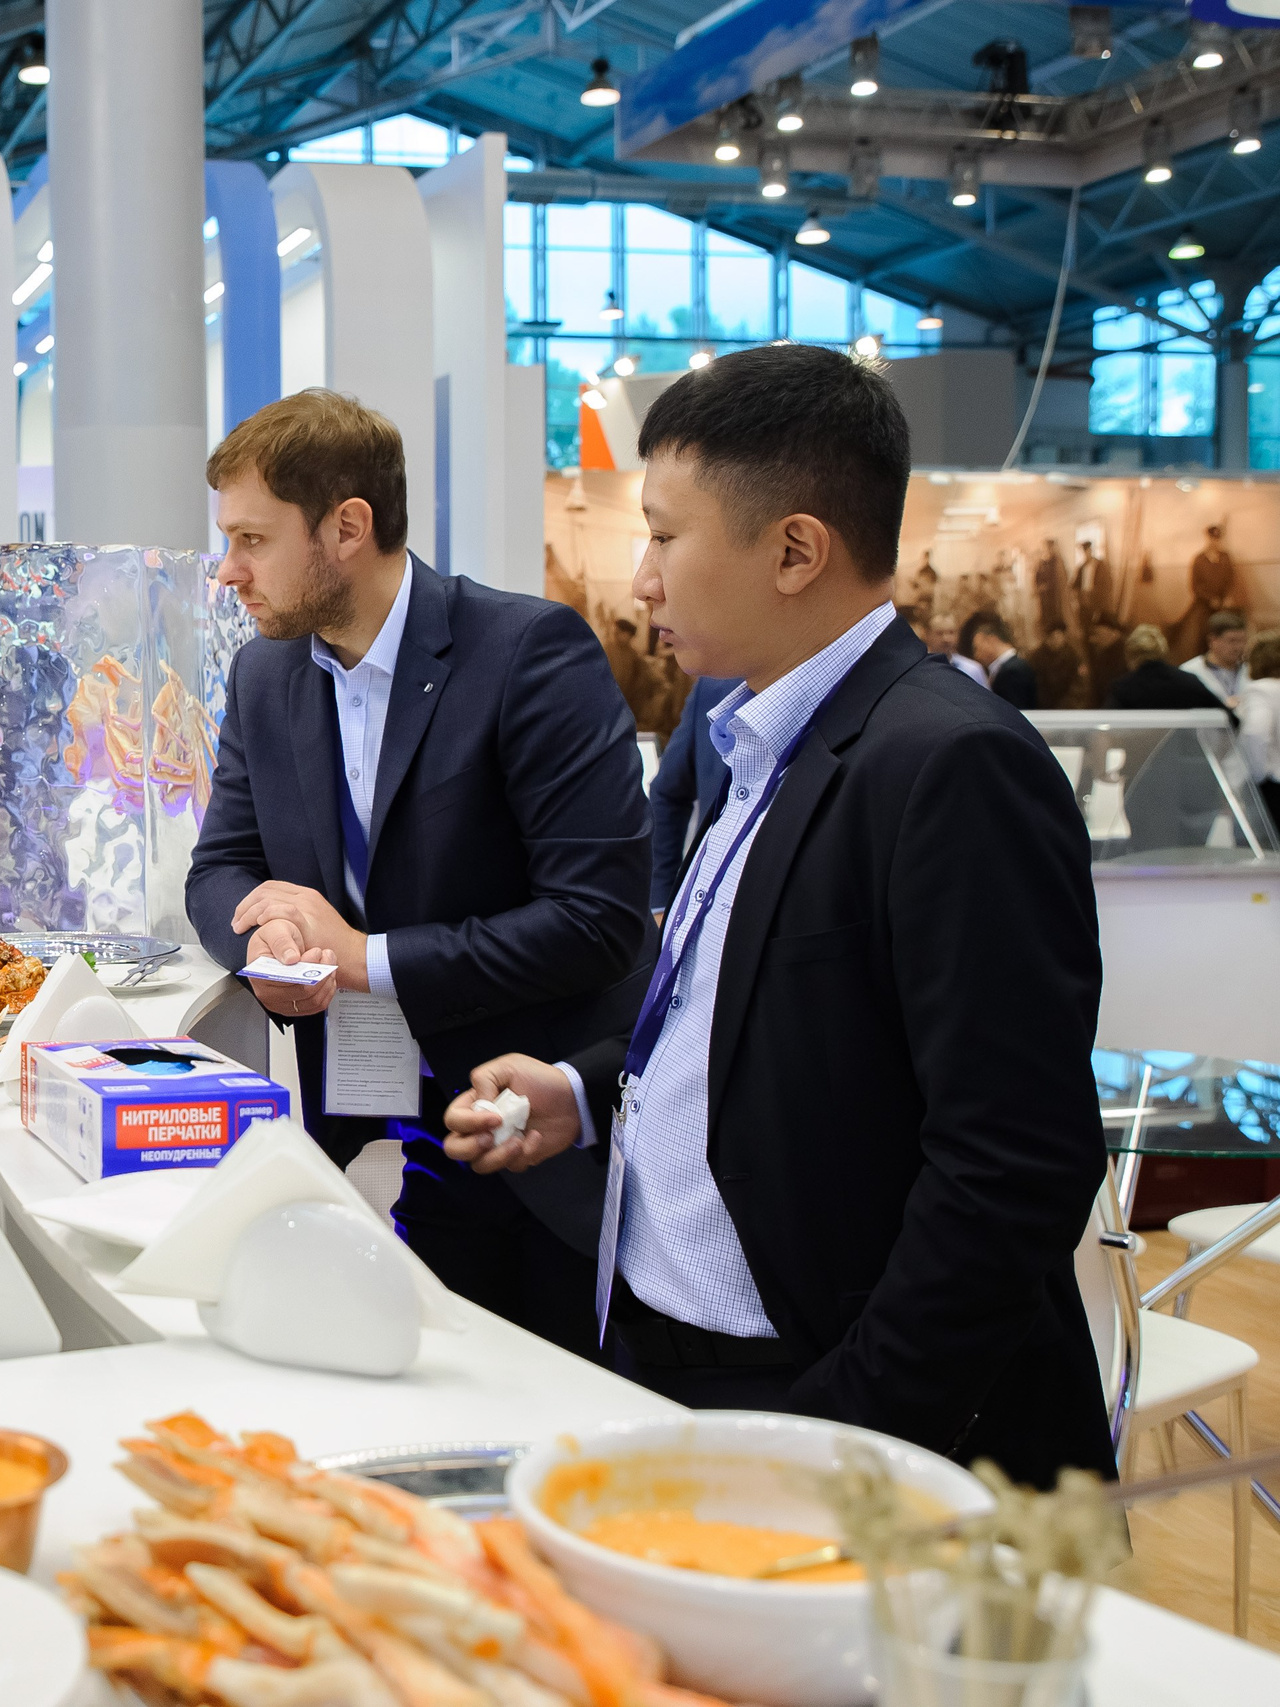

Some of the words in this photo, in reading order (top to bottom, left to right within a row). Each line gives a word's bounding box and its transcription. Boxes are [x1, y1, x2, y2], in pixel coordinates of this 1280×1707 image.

[122, 1107, 222, 1126] НИТРИЛОВЫЕ
[239, 1106, 273, 1118] размер
[148, 1124, 222, 1142] ПЕРЧАТКИ
[140, 1148, 222, 1163] НЕОПУДРЕННЫЕ
